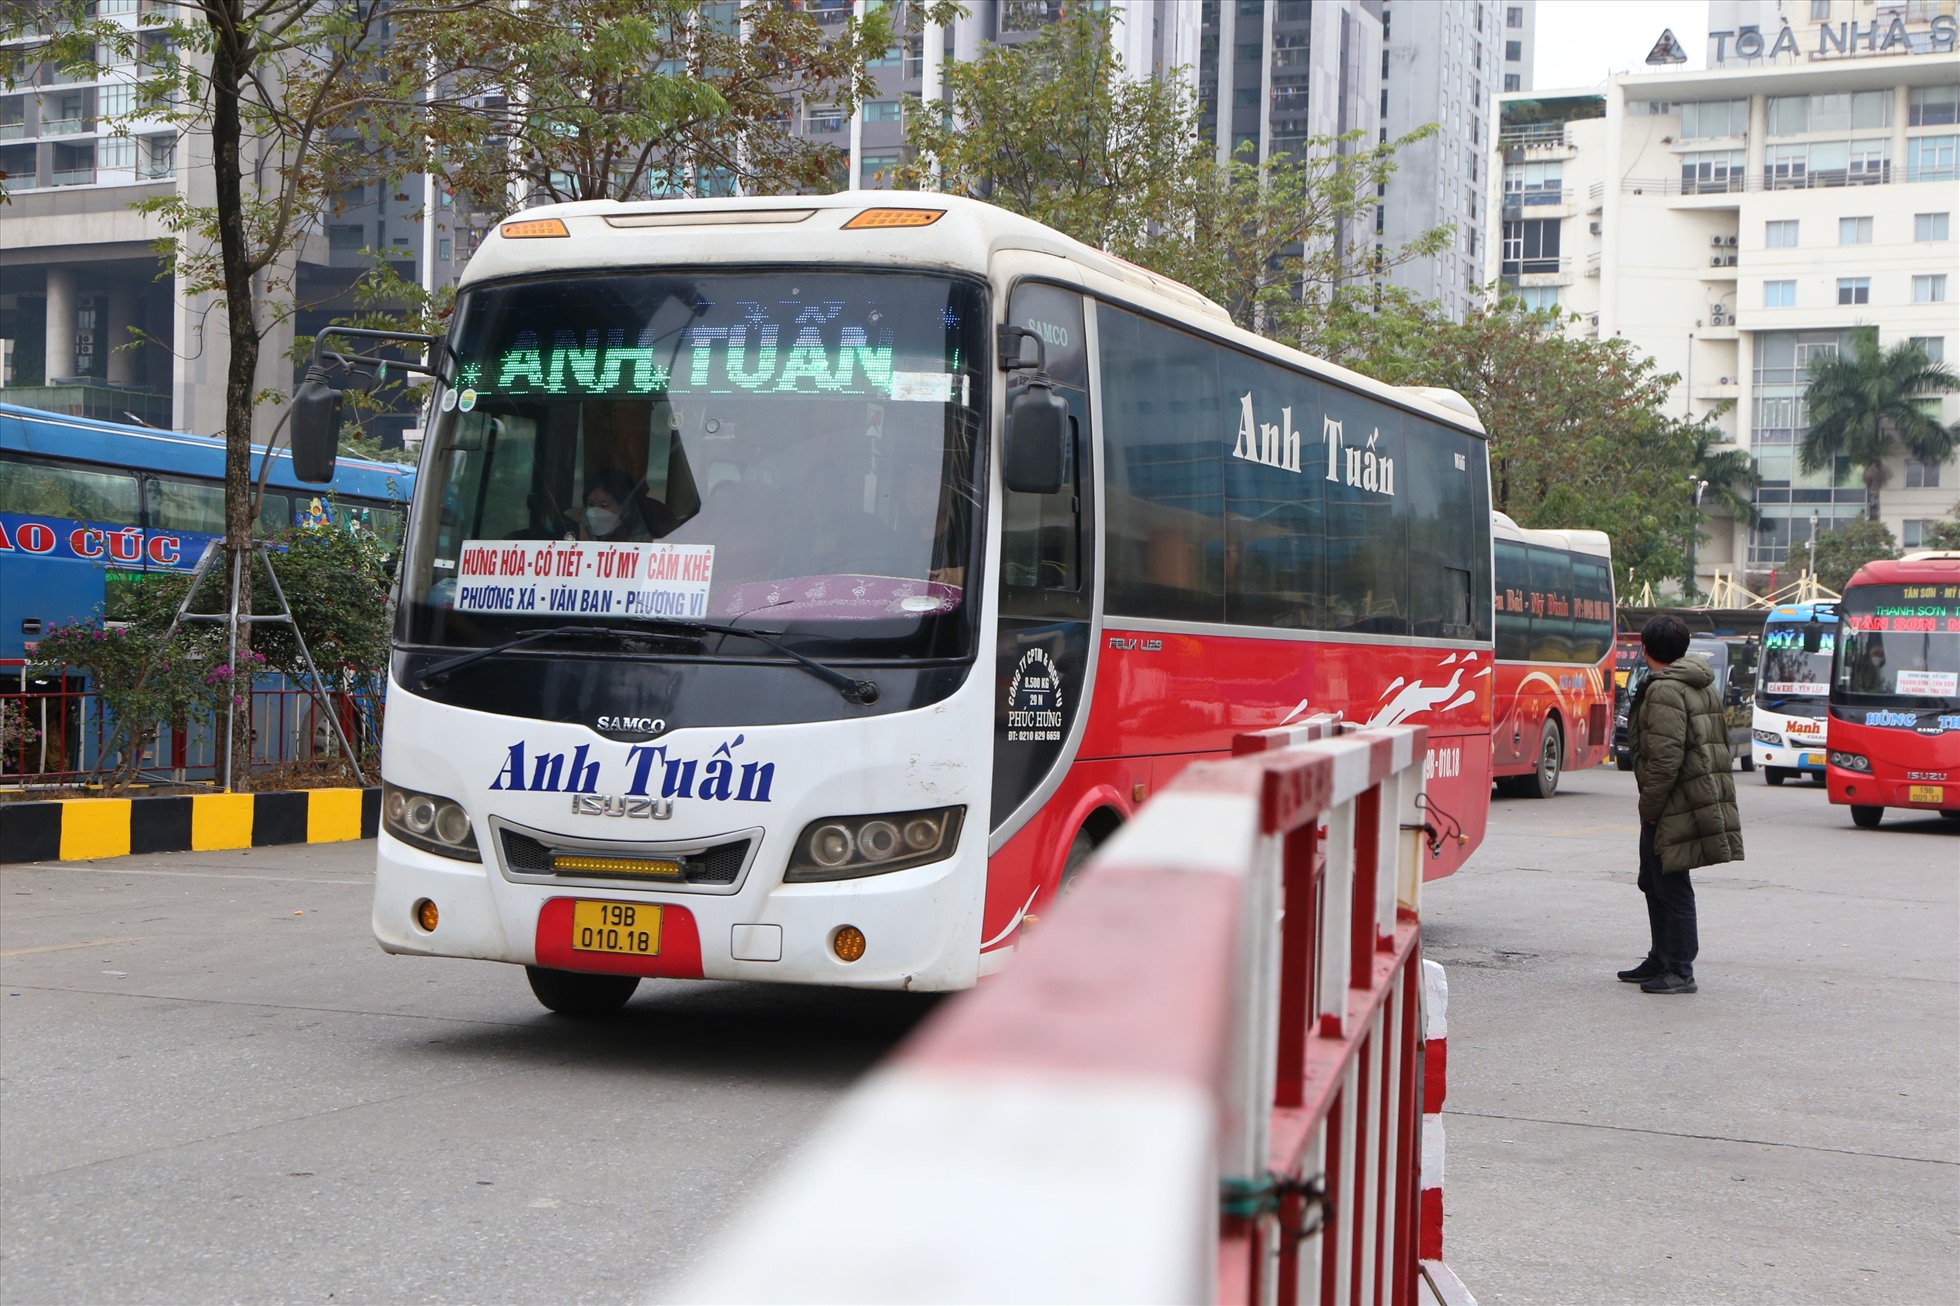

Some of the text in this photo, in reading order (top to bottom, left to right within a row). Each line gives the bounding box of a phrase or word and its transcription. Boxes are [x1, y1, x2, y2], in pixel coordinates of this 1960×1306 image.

[1709, 17, 1800, 60] TOÀ
[1819, 10, 1913, 53] NHÀ
[1028, 319, 1068, 347] SAMCO
[498, 329, 653, 391] ANH
[1232, 391, 1395, 495] Anh Tuấn
[69, 527, 180, 566] CÚC
[461, 547, 497, 576] HƯNG
[500, 544, 525, 576] HÓA
[534, 541, 556, 577] CỔ
[556, 542, 583, 578] TIẾT
[596, 544, 617, 578] TỨ
[617, 547, 639, 579] MỸ
[682, 548, 712, 582] KHÊ
[460, 585, 514, 610] PHƯƠNG
[517, 583, 537, 610] XÁ
[550, 584, 578, 611] VĂN
[1506, 589, 1523, 612] Bái
[1904, 587, 1919, 598] TÂN
[1921, 587, 1936, 599] SƠN
[1944, 586, 1957, 599] MỸ
[1876, 605, 1914, 616] THANH
[1917, 605, 1946, 616] SƠN
[1850, 615, 1889, 631] TÂN
[1893, 616, 1936, 631] SƠN
[1109, 638, 1137, 650] FELIX
[1019, 655, 1027, 673] TY
[1041, 677, 1050, 689] KG
[1029, 694, 1043, 706] 29 N
[597, 716, 666, 734] SAMCO
[1008, 706, 1062, 727] PHÚC HƯNG
[1018, 730, 1034, 741] 0210
[1034, 730, 1045, 741] 629
[1785, 720, 1820, 736] Mạnh
[488, 733, 775, 803] Anh Tuấn
[1907, 771, 1947, 780] ISUZU
[571, 793, 674, 820] ISUZU
[601, 905, 636, 926] 19B
[581, 927, 650, 952] 010.18
